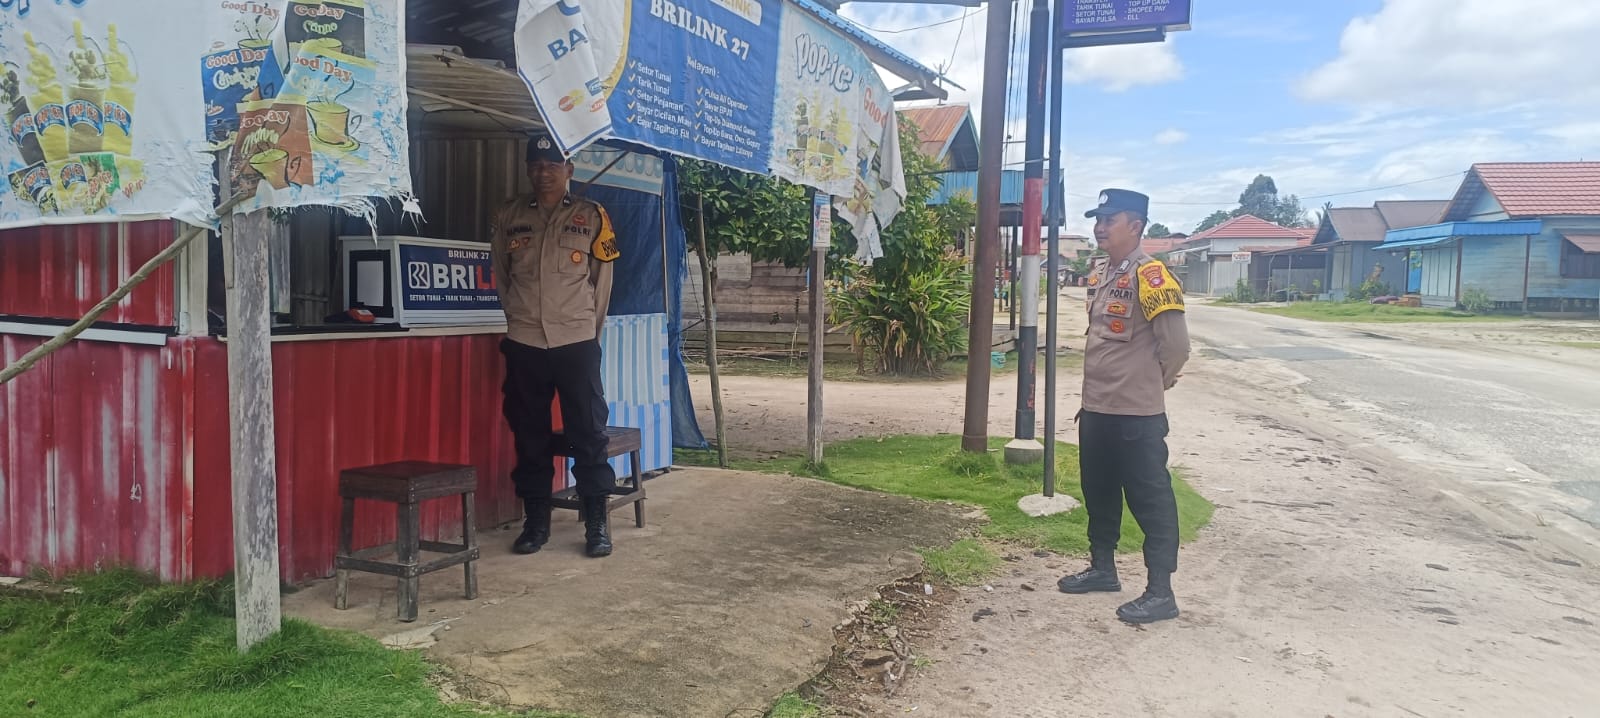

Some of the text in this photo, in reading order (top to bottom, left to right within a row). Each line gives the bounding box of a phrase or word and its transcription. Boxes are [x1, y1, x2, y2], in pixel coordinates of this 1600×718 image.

[221, 0, 280, 19] Good Day
[1127, 6, 1153, 14] SHOPEE
[1096, 15, 1117, 23] PULSA
[650, 0, 750, 61] BRILINK 27
[206, 50, 238, 69] Good
[323, 61, 354, 84] Day
[637, 62, 672, 84] Setor Tunai
[637, 75, 670, 96] Tarik Tunai
[636, 89, 684, 112] Setor Pinjaman
[704, 88, 720, 100] Pulsa
[727, 96, 749, 111] Operator
[704, 99, 719, 113] Bayar
[636, 102, 654, 116] Bayar
[654, 108, 677, 122] Cicilan
[653, 121, 679, 135] Tagihan
[703, 123, 720, 137] Top-Up
[721, 116, 743, 133] Diamond
[701, 135, 716, 148] Bayar
[565, 225, 591, 236] POLRI
[448, 250, 489, 260] BRILINK 27
[476, 295, 498, 303] TRANSFER
[1110, 289, 1133, 300] POLRI
